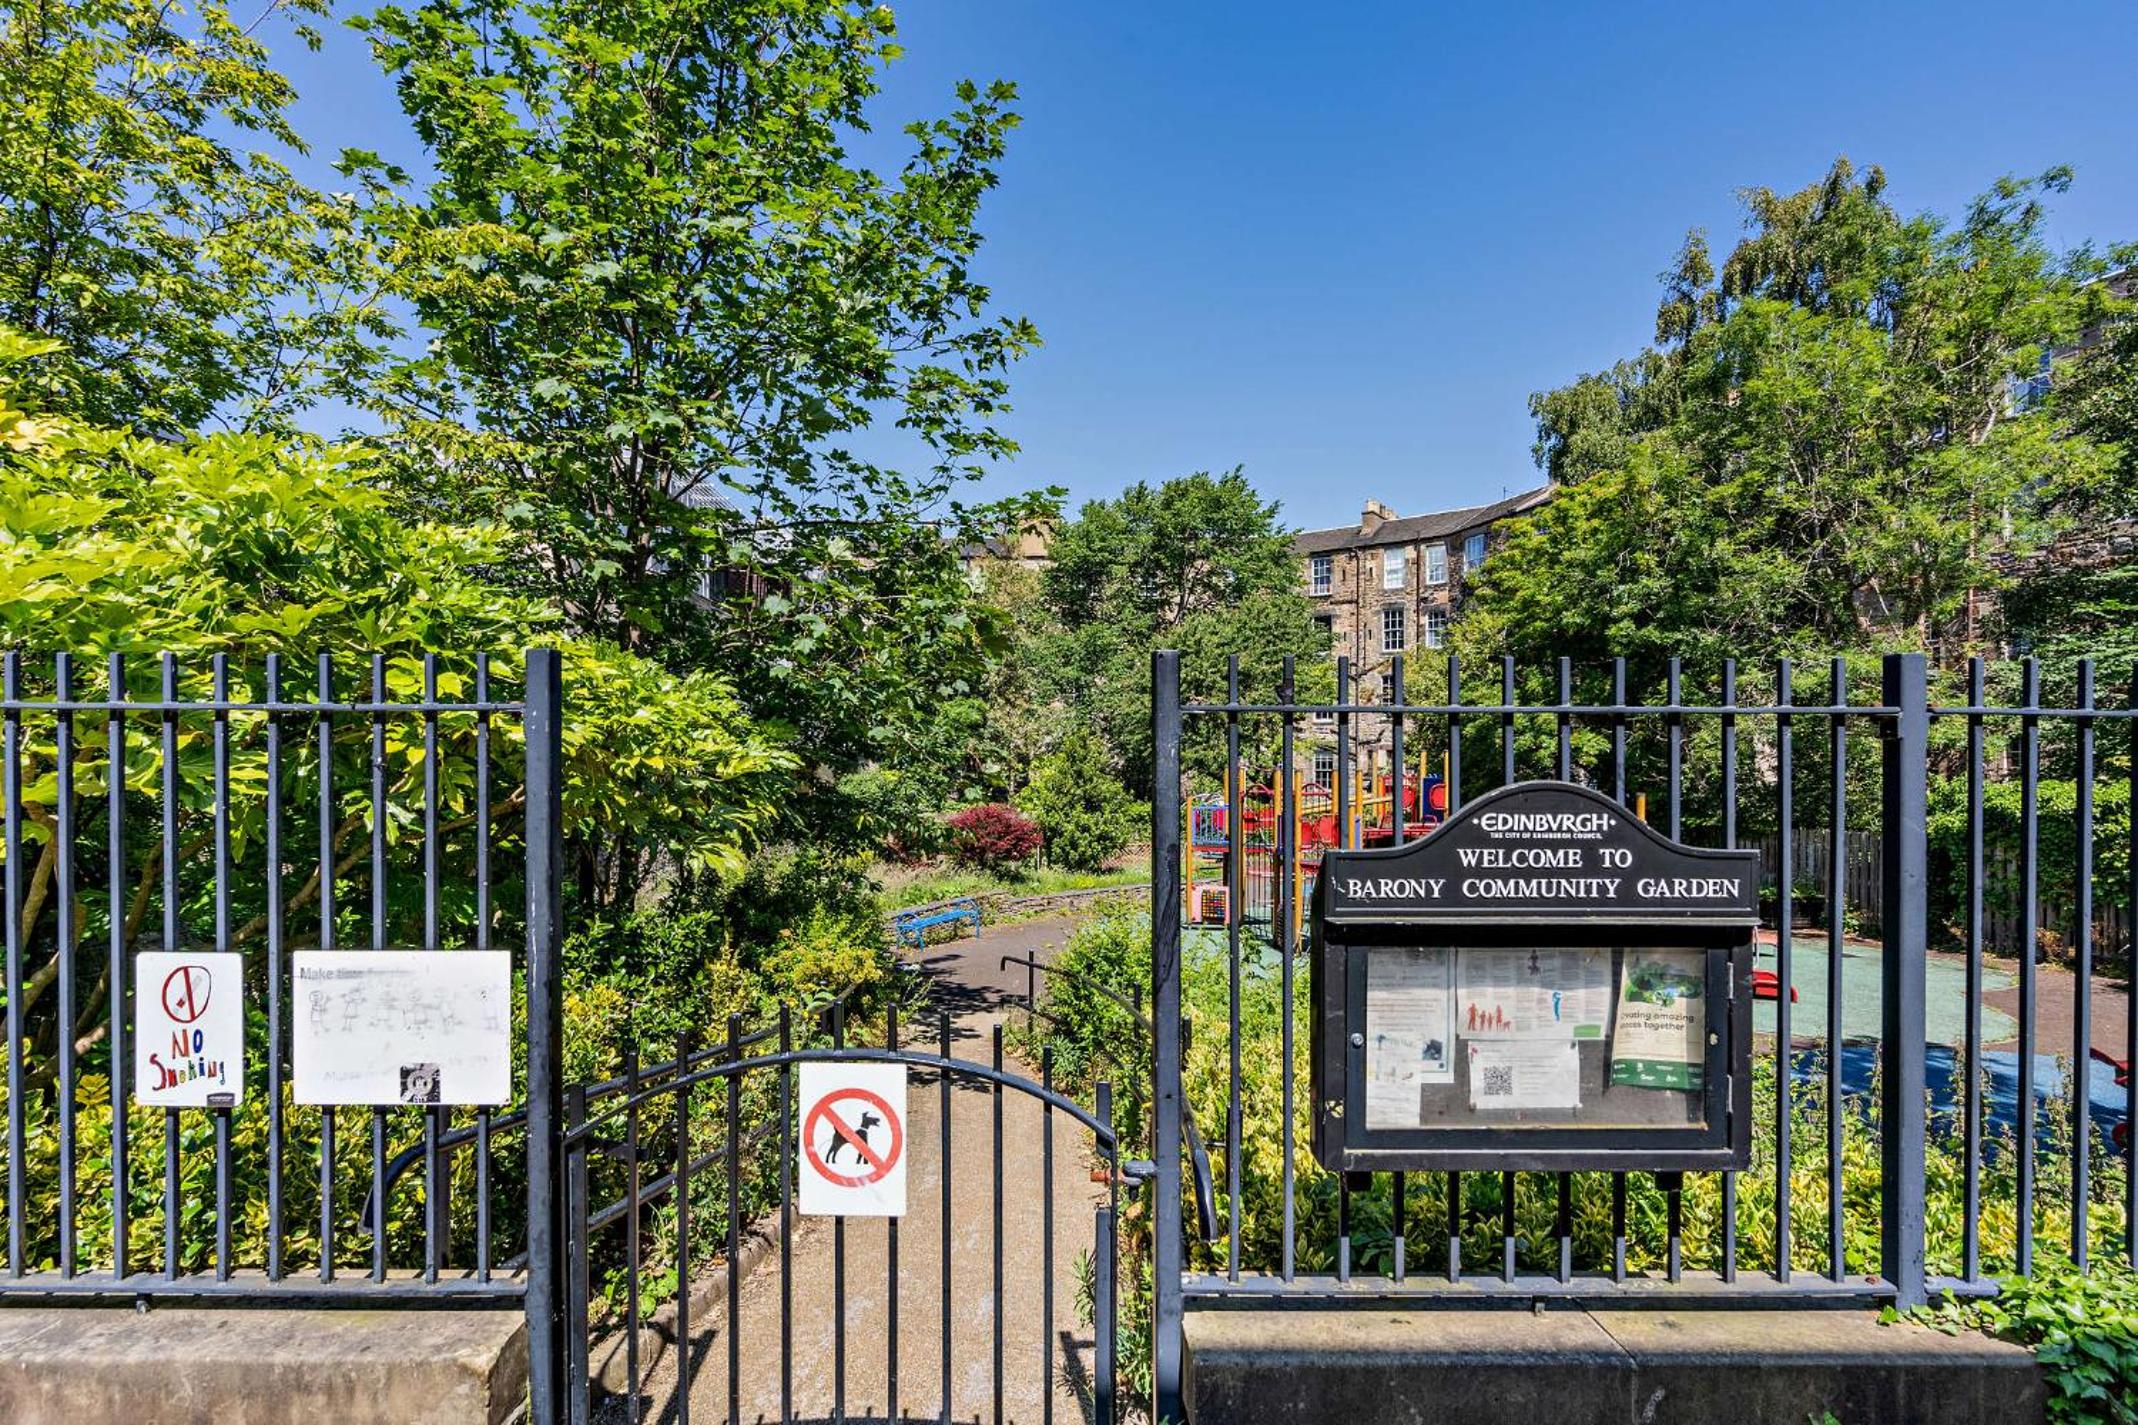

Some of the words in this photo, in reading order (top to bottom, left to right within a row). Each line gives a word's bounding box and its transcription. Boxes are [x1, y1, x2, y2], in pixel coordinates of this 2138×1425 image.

[1573, 832, 1603, 840] COUNCIL
[1457, 848, 1582, 868] WELCOME
[1600, 848, 1633, 868] TO
[1347, 878, 1446, 899] BARONY
[1462, 878, 1622, 899] COMMUNITY
[1637, 878, 1741, 898] GARDEN
[299, 967, 334, 980] Make
[1644, 1021, 1685, 1031] together
[1653, 1012, 1695, 1024] amazing
[172, 1028, 204, 1060] NO
[149, 1053, 226, 1091] Smoking
